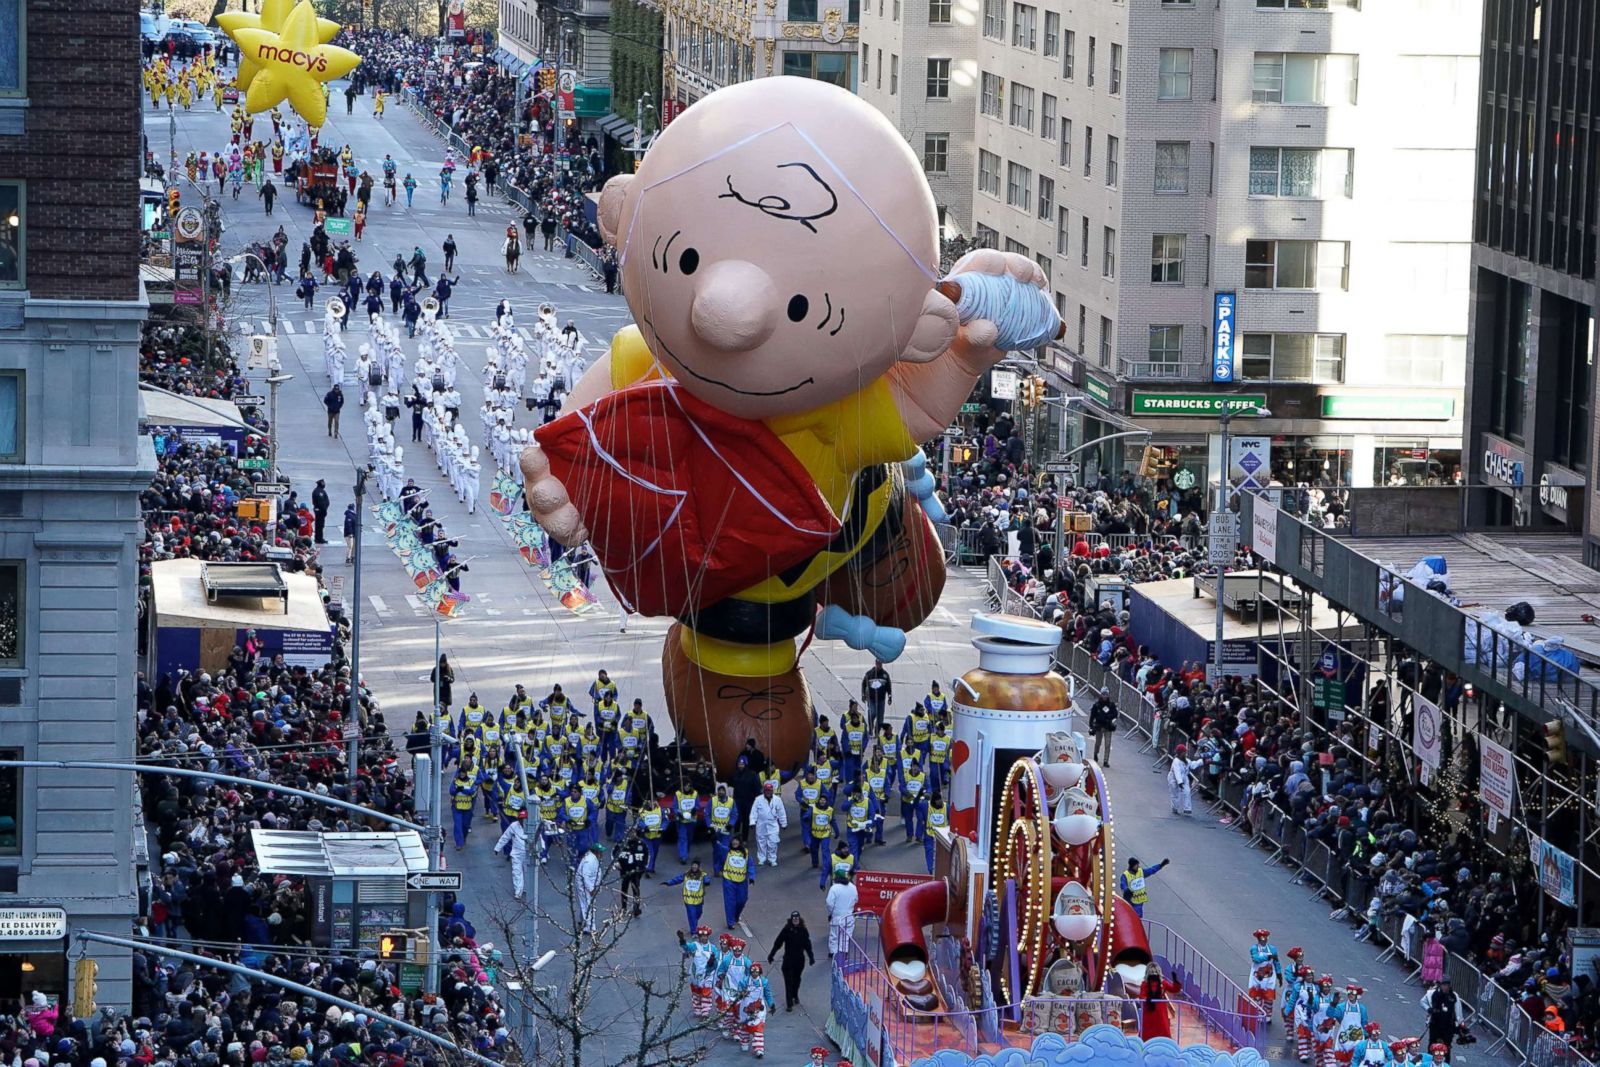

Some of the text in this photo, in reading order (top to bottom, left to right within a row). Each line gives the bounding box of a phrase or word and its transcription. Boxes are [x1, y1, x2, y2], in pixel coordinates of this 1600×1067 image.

[1217, 306, 1231, 360] PARK
[1144, 399, 1211, 409] STARBUCKS
[1484, 450, 1513, 485] CHASE
[1215, 515, 1230, 524] BUS
[1213, 526, 1232, 534] LANE
[1072, 801, 1093, 810] CACAO
[413, 877, 457, 885] ONE WAY
[318, 884, 326, 923] Newsstand
[19, 911, 38, 919] LUNCH
[42, 911, 63, 919] DINNER
[1057, 978, 1078, 986] CACAO
